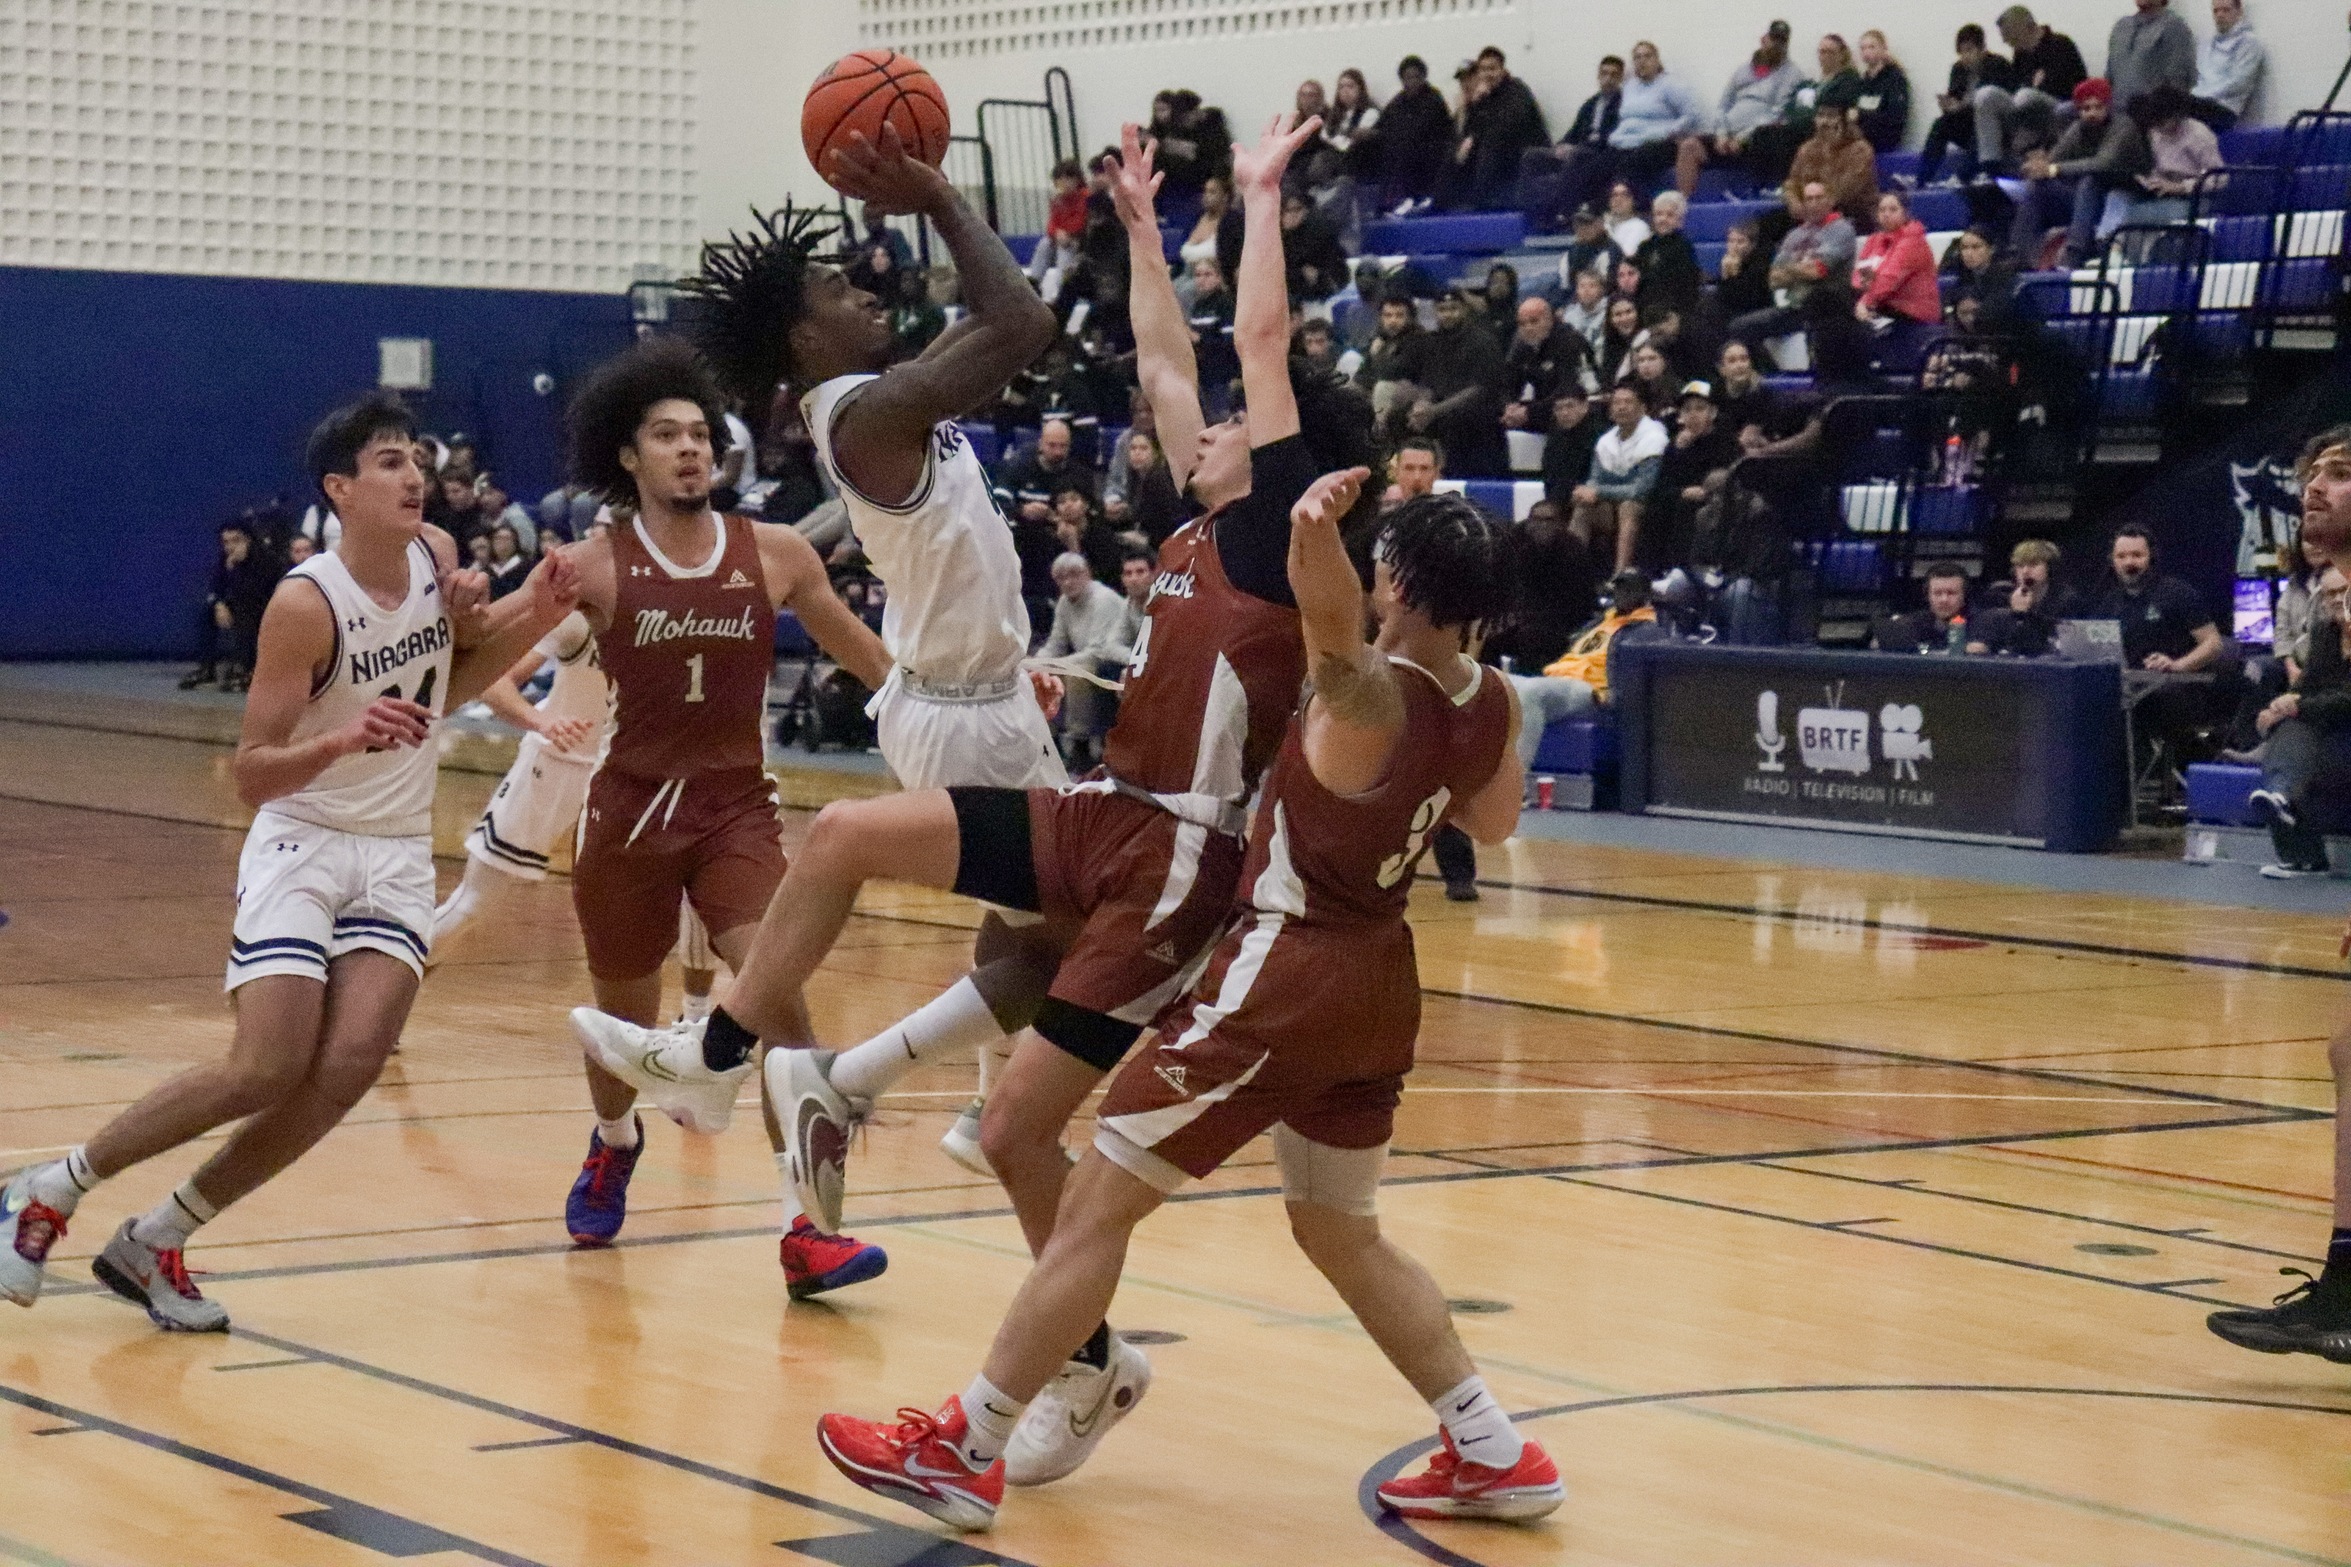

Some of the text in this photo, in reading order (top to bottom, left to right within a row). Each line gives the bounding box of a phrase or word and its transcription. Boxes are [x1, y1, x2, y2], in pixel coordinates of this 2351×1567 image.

[634, 604, 755, 648] Mohawk
[350, 616, 451, 685] NIAGARA
[685, 653, 705, 703] 1
[1803, 726, 1861, 751] BRTF
[1744, 777, 1934, 806] RADIO TELEVISION FILM
